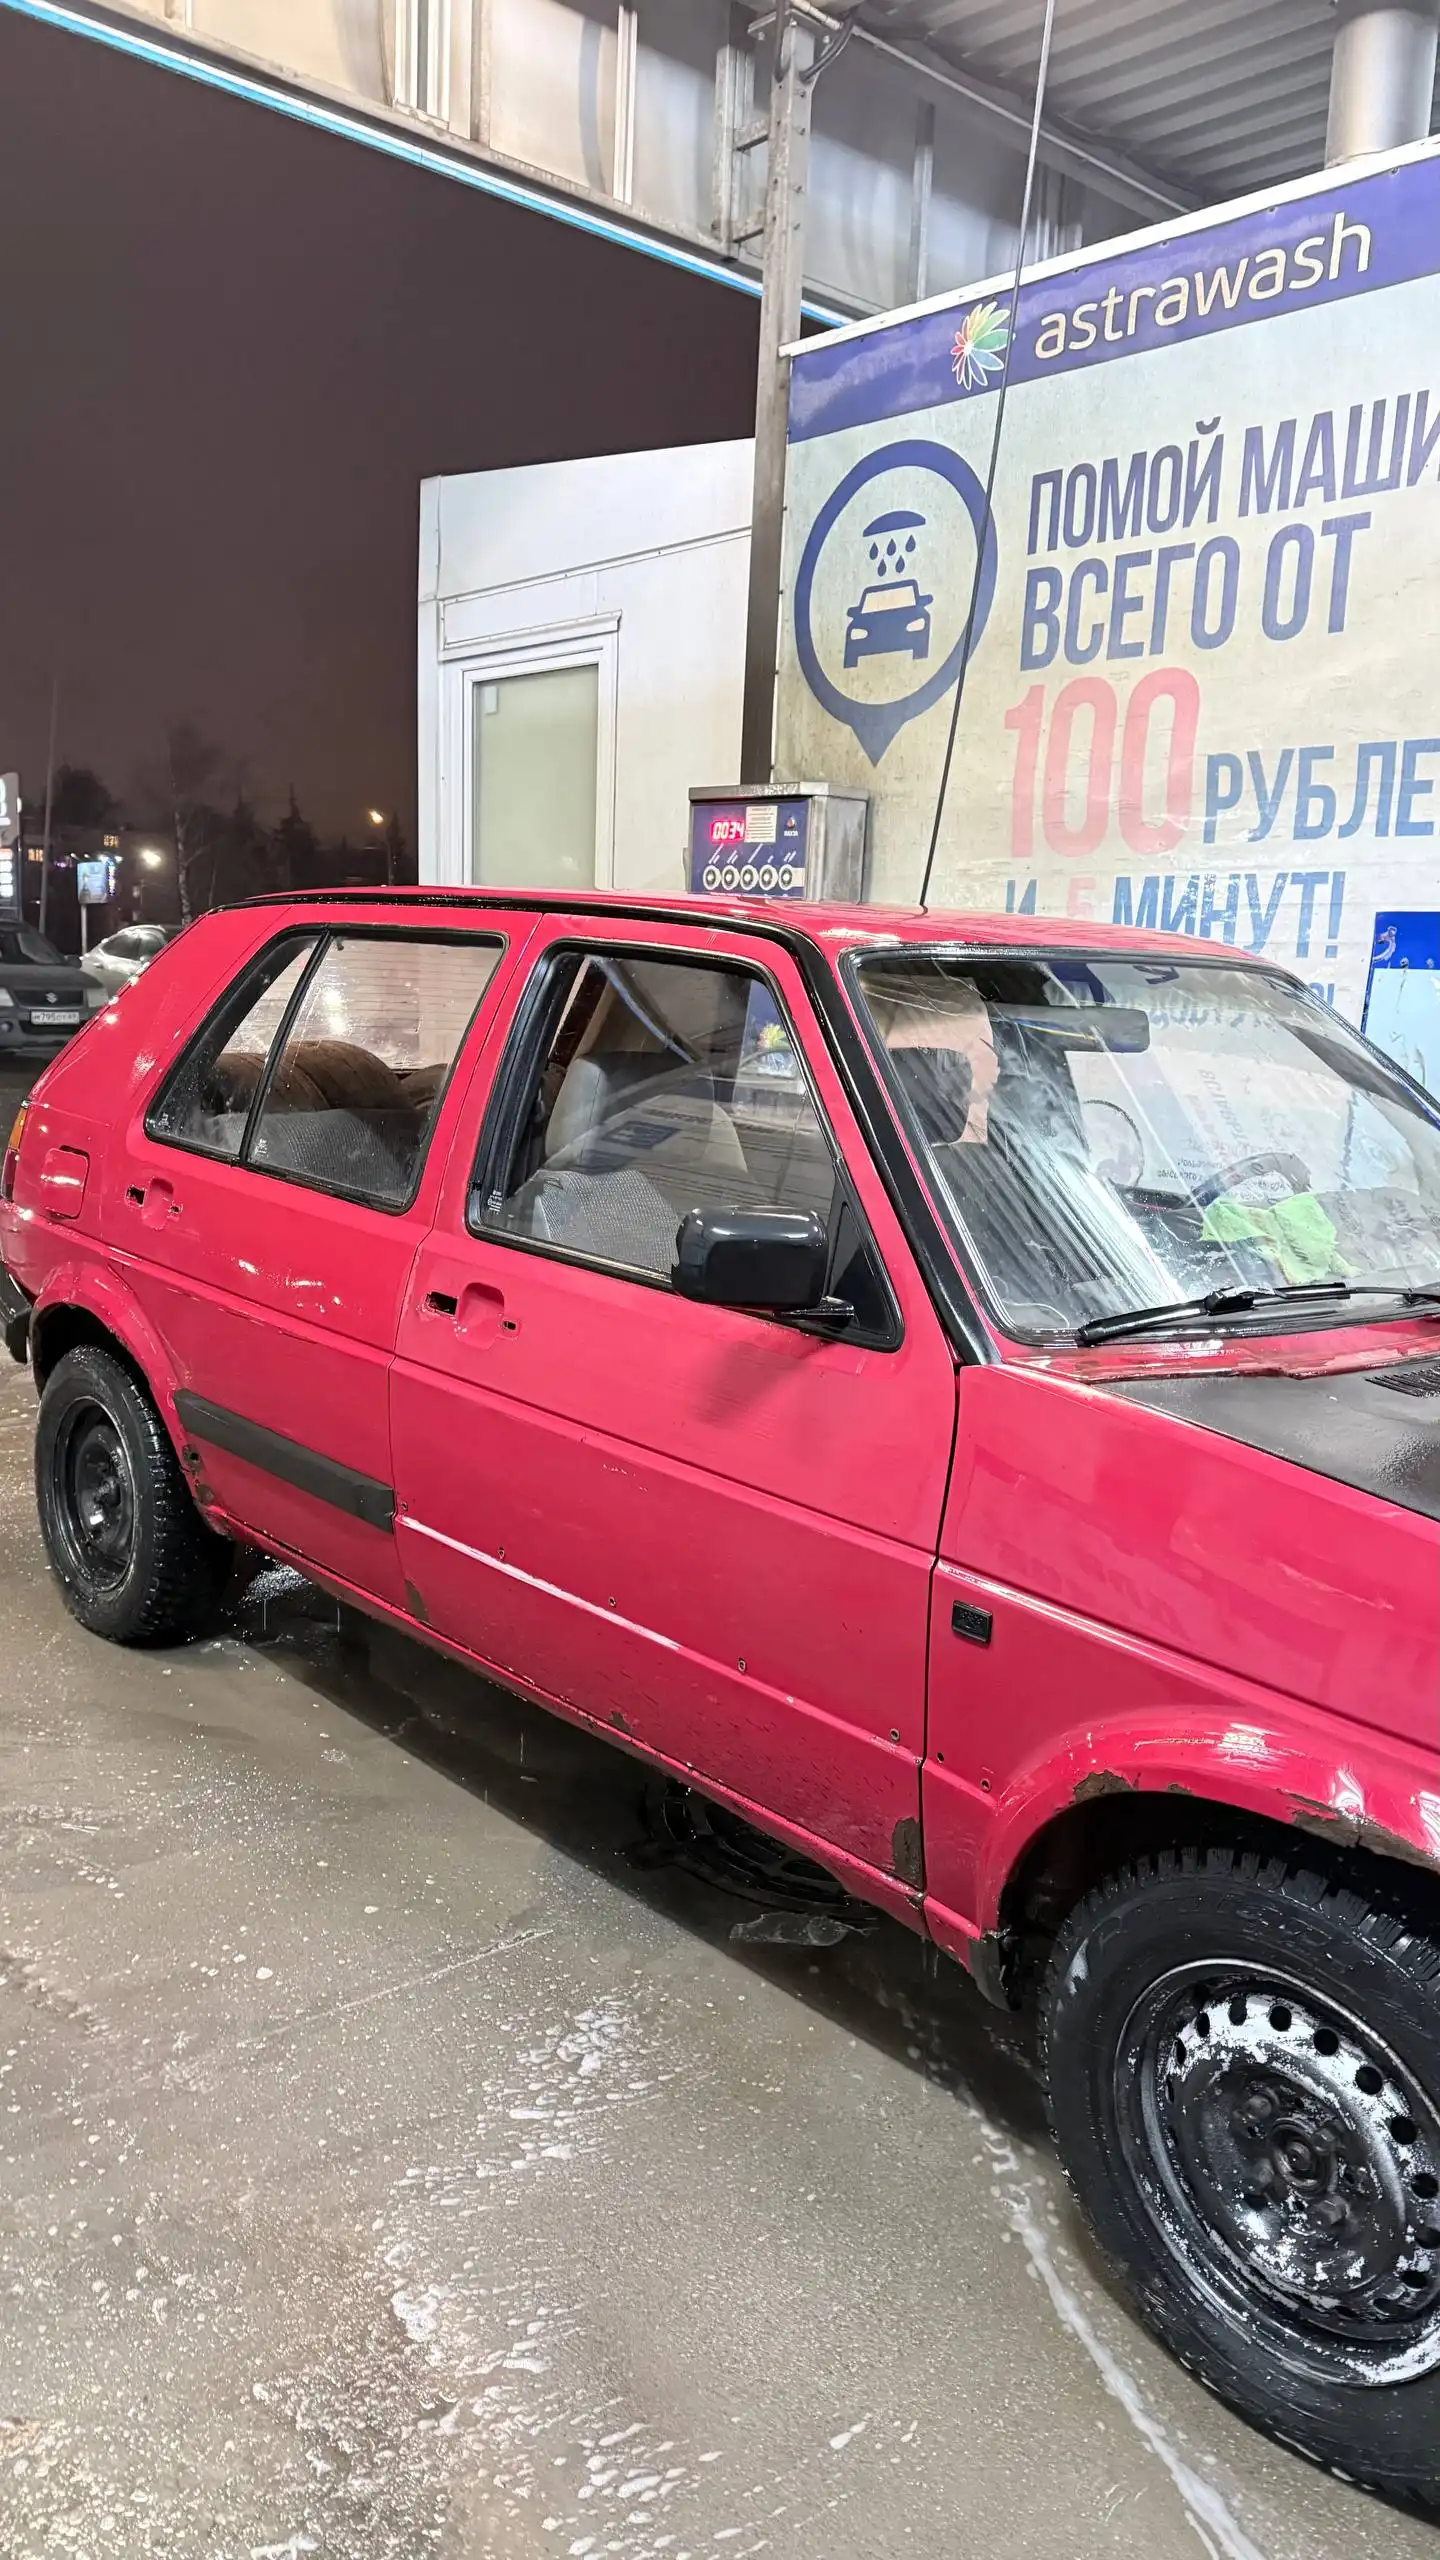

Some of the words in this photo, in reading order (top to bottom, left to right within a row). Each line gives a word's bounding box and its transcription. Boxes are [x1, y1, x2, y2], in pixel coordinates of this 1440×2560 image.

[1035, 212, 1372, 359] astrawash
[1027, 416, 1225, 555] ПОМОЙ
[1020, 535, 1241, 672] ВСЕГО
[1261, 512, 1372, 641] ОТ
[712, 821, 744, 840] 0034
[1003, 667, 1200, 858] 100
[1203, 738, 1440, 844] РУБЛЕ
[1112, 871, 1345, 958] МИНУТ!
